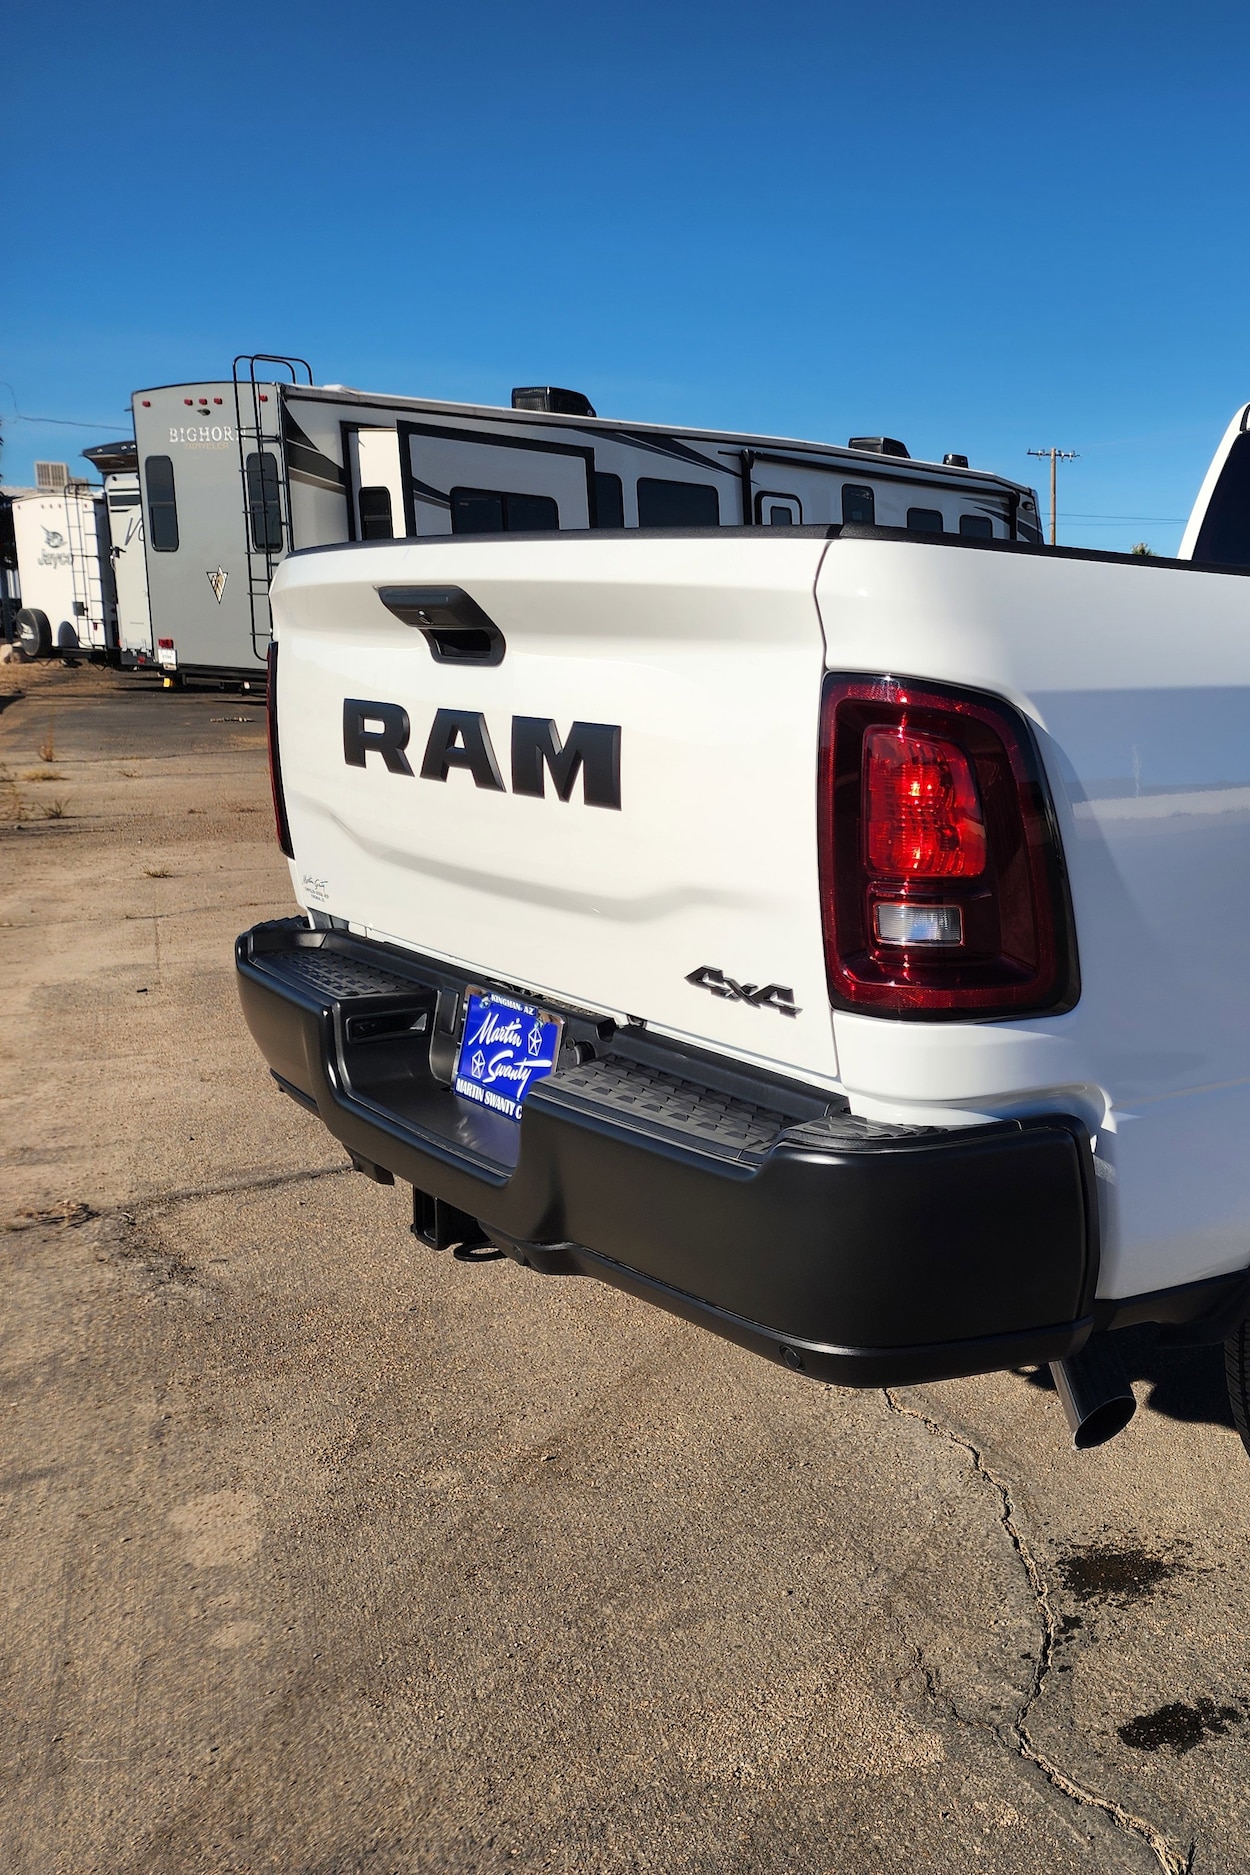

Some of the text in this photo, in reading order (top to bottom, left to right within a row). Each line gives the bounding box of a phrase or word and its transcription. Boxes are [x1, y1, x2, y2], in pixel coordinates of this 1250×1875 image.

[169, 426, 246, 443] BIGHORN
[343, 698, 622, 811] RAM
[523, 1005, 535, 1016] AZ
[468, 1012, 522, 1047] Martin
[482, 1050, 552, 1100] Swanty
[456, 1078, 484, 1102] MARTIN
[484, 1091, 516, 1116] SWANTY
